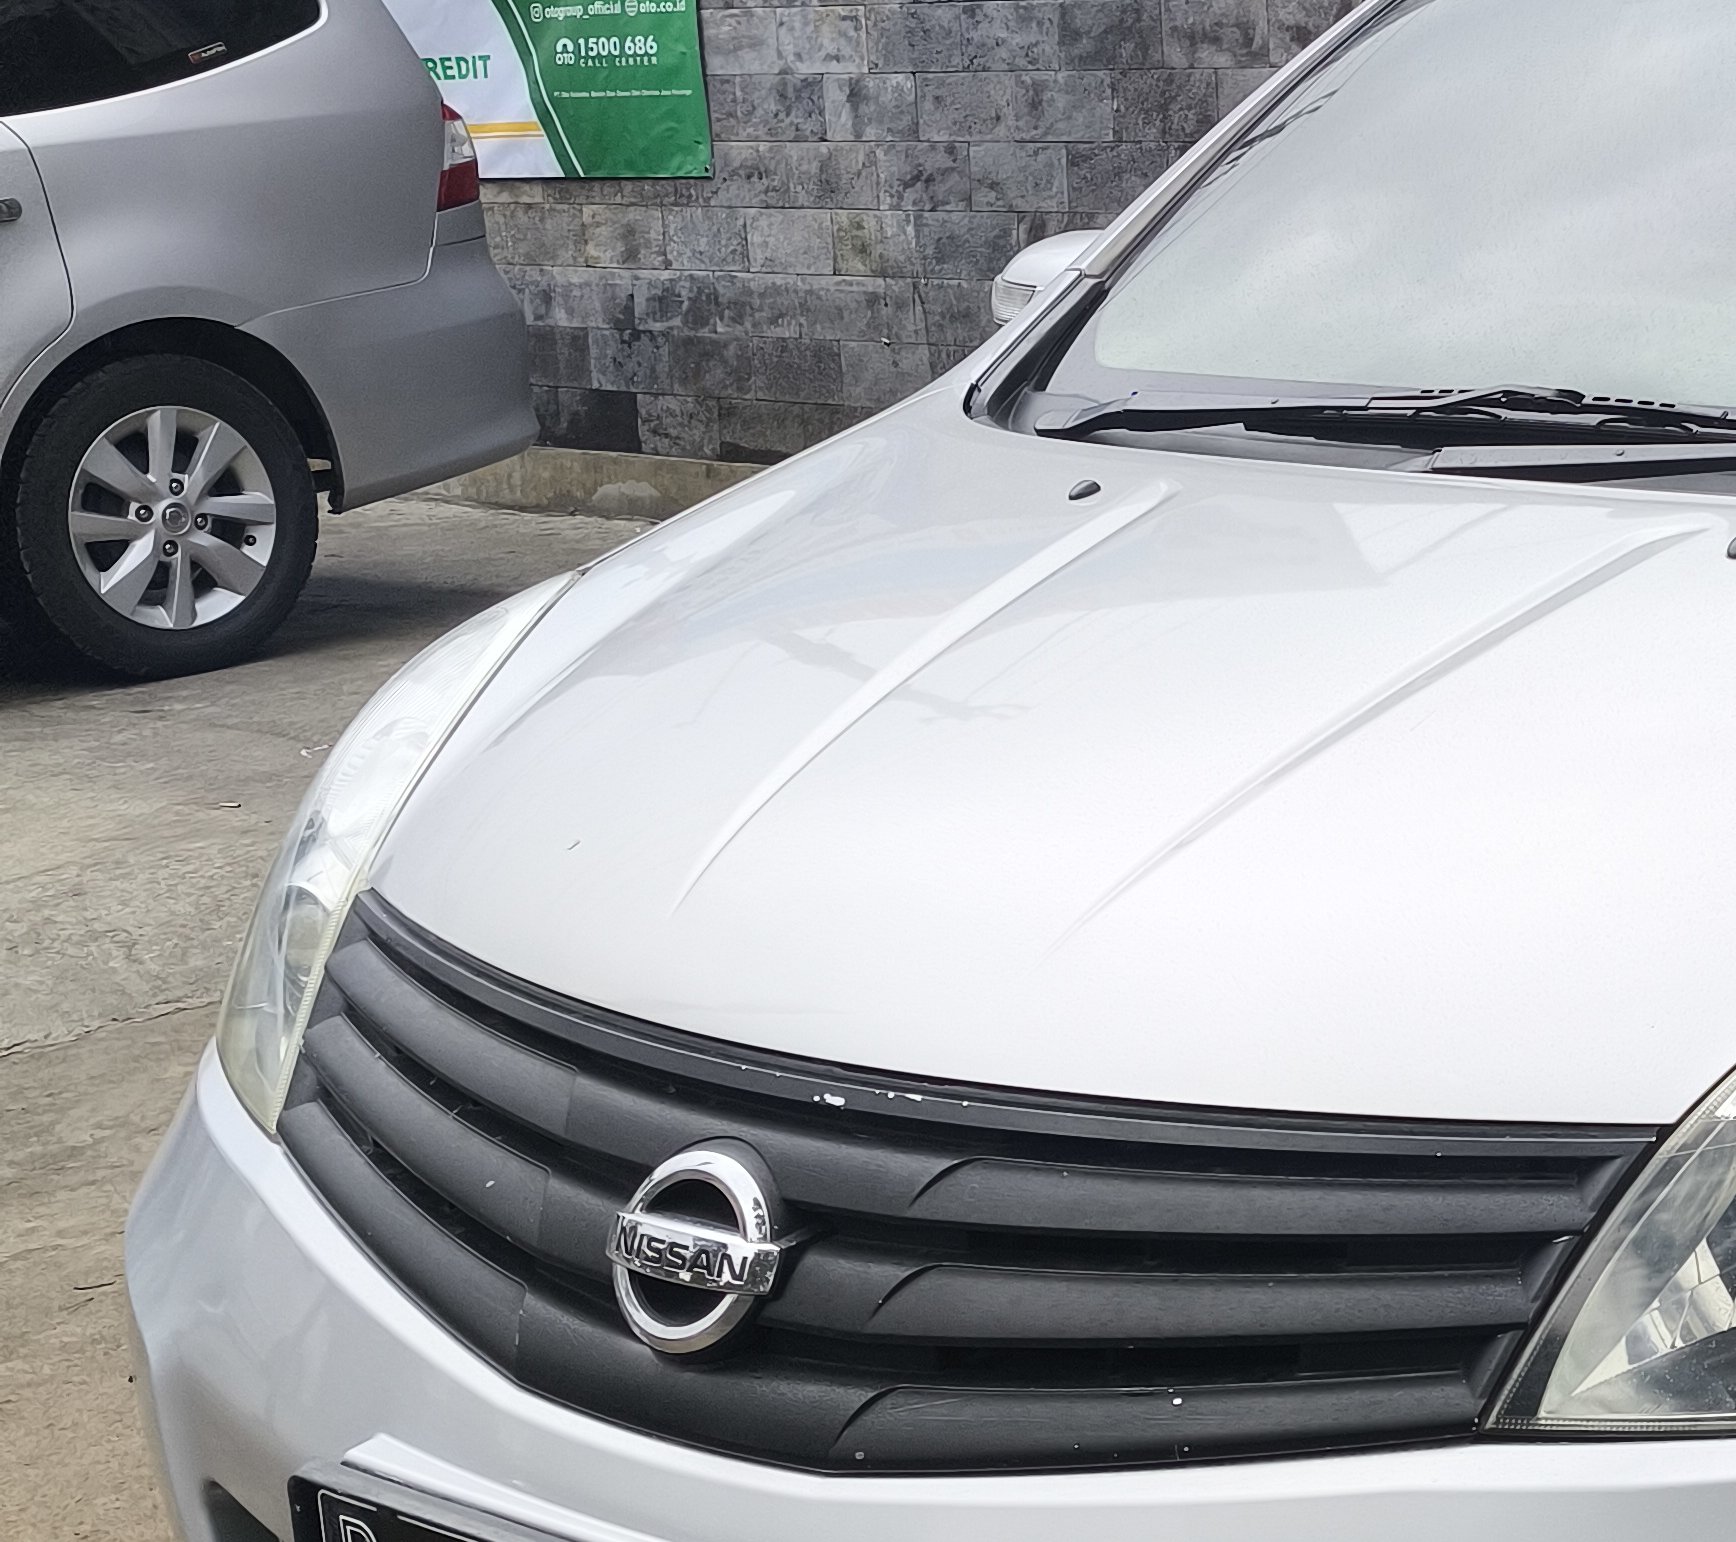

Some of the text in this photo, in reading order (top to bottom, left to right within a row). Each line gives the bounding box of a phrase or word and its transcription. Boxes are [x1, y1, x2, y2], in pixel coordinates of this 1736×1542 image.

[577, 35, 658, 57] 1500 686
[421, 53, 491, 82] REDIT
[555, 53, 575, 67] OTO
[615, 1223, 750, 1286] NISSAN
